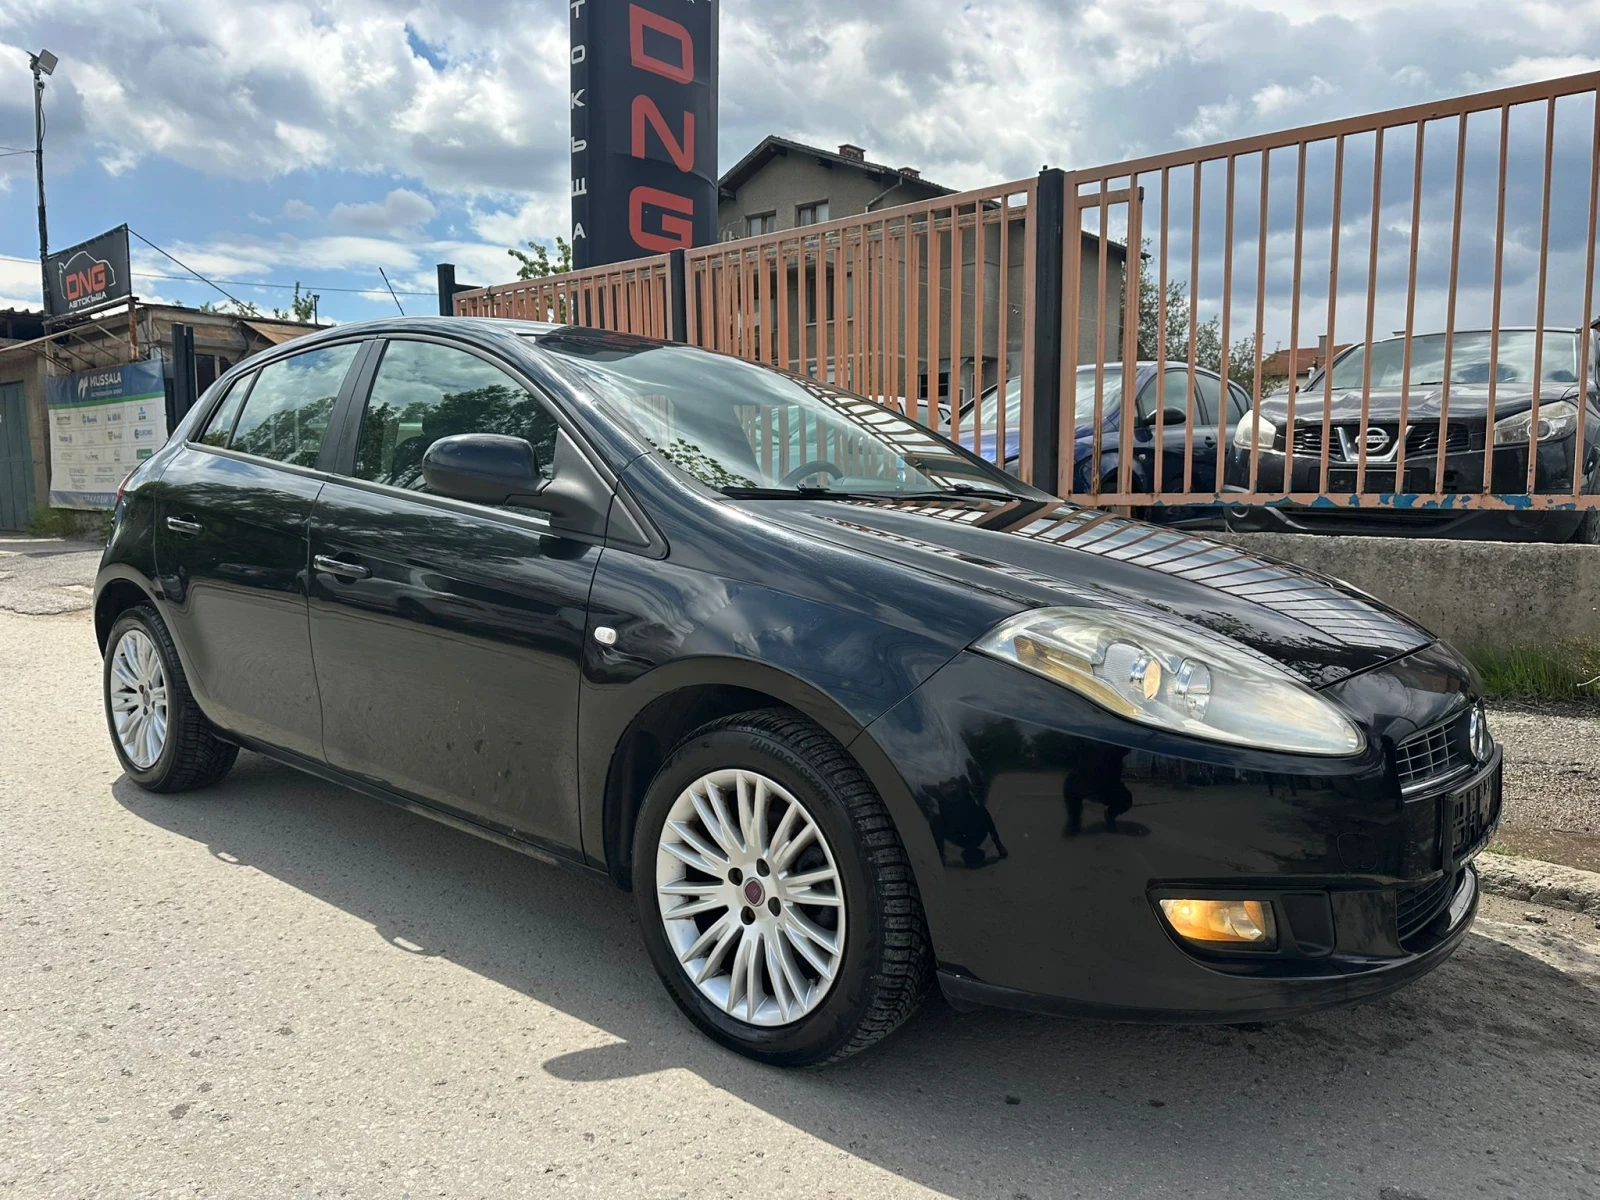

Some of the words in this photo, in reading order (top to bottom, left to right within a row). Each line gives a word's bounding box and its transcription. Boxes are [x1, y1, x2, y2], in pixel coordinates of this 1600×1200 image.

[628, 3, 695, 253] DNG
[65, 263, 106, 300] DNG
[90, 372, 122, 386] MUSSALA
